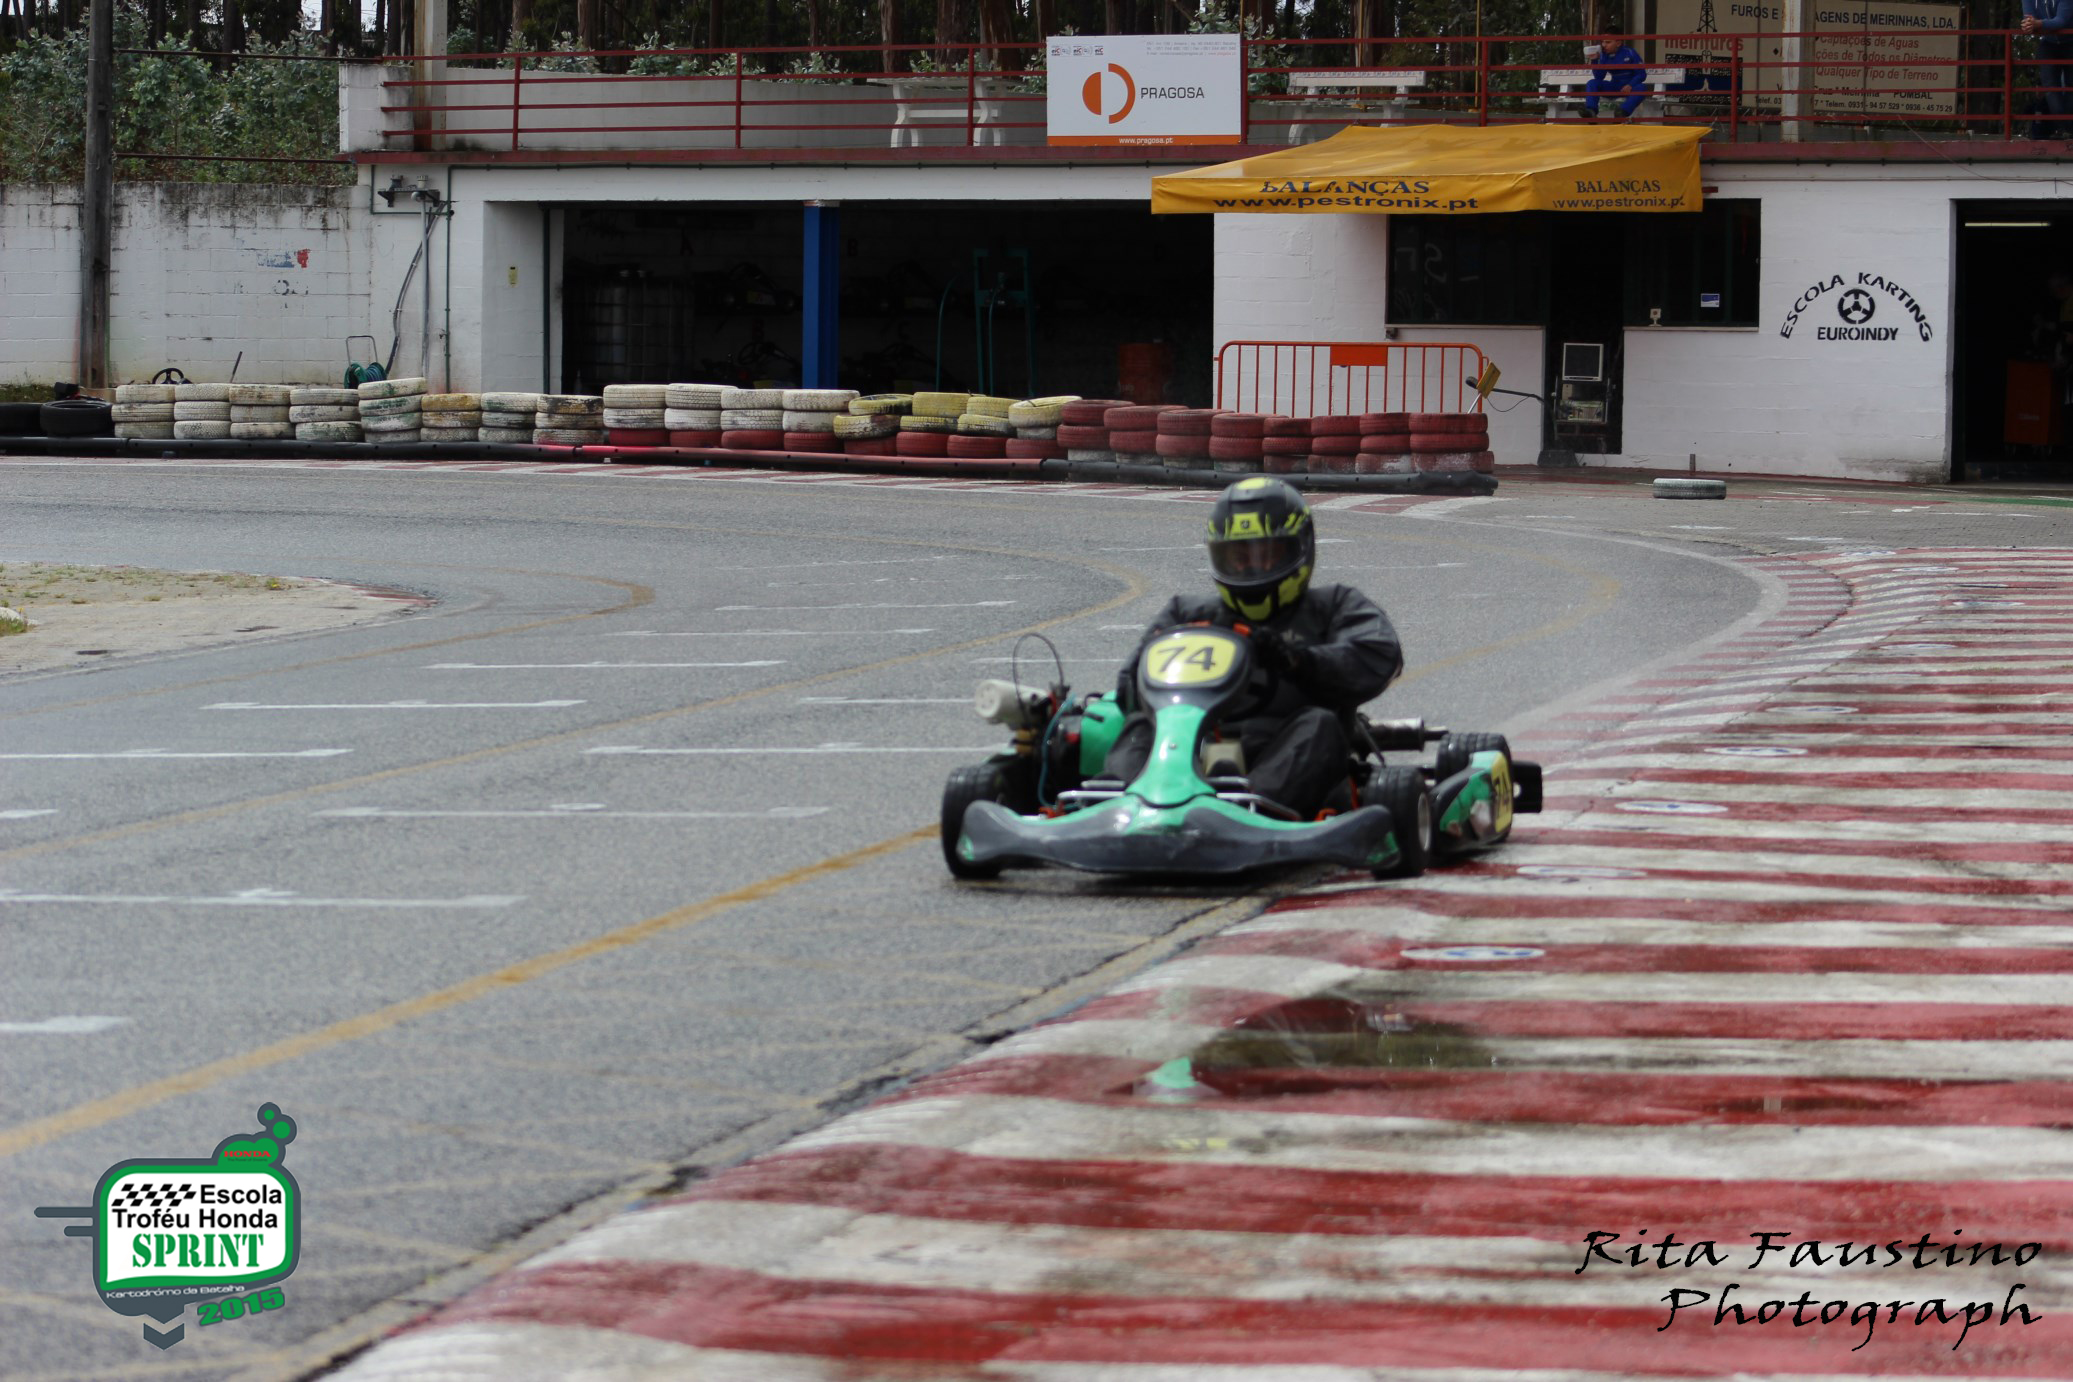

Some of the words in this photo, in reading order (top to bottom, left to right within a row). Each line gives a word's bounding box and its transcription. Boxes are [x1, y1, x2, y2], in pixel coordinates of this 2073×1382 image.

[1731, 4, 1768, 18] FUROS
[1772, 8, 1778, 19] E
[1815, 11, 1850, 24] AGENS
[1853, 12, 1867, 24] DE
[1870, 13, 1930, 29] MEIRINHAS,
[1932, 17, 1956, 29] LDA.
[1874, 36, 1886, 47] de
[1842, 50, 1853, 61] de
[1857, 50, 1886, 62] Todos
[1816, 65, 1862, 79] Qualquer
[1887, 68, 1899, 80] de
[1902, 68, 1939, 81] Terreno
[1140, 86, 1205, 99] PRAGOSA
[1119, 136, 1174, 145] www.pragosa.pt
[1260, 179, 1430, 196] BALANÇAS
[1575, 179, 1661, 195] BALANÇAS
[1213, 195, 1478, 211] www.pestronix.pt
[1553, 196, 1685, 208] www.pestronix.pt
[1779, 273, 1846, 340] ESCOLA
[1857, 271, 1934, 342] KARTING
[1816, 326, 1899, 341] EUROINDY
[1155, 645, 1217, 673] 74
